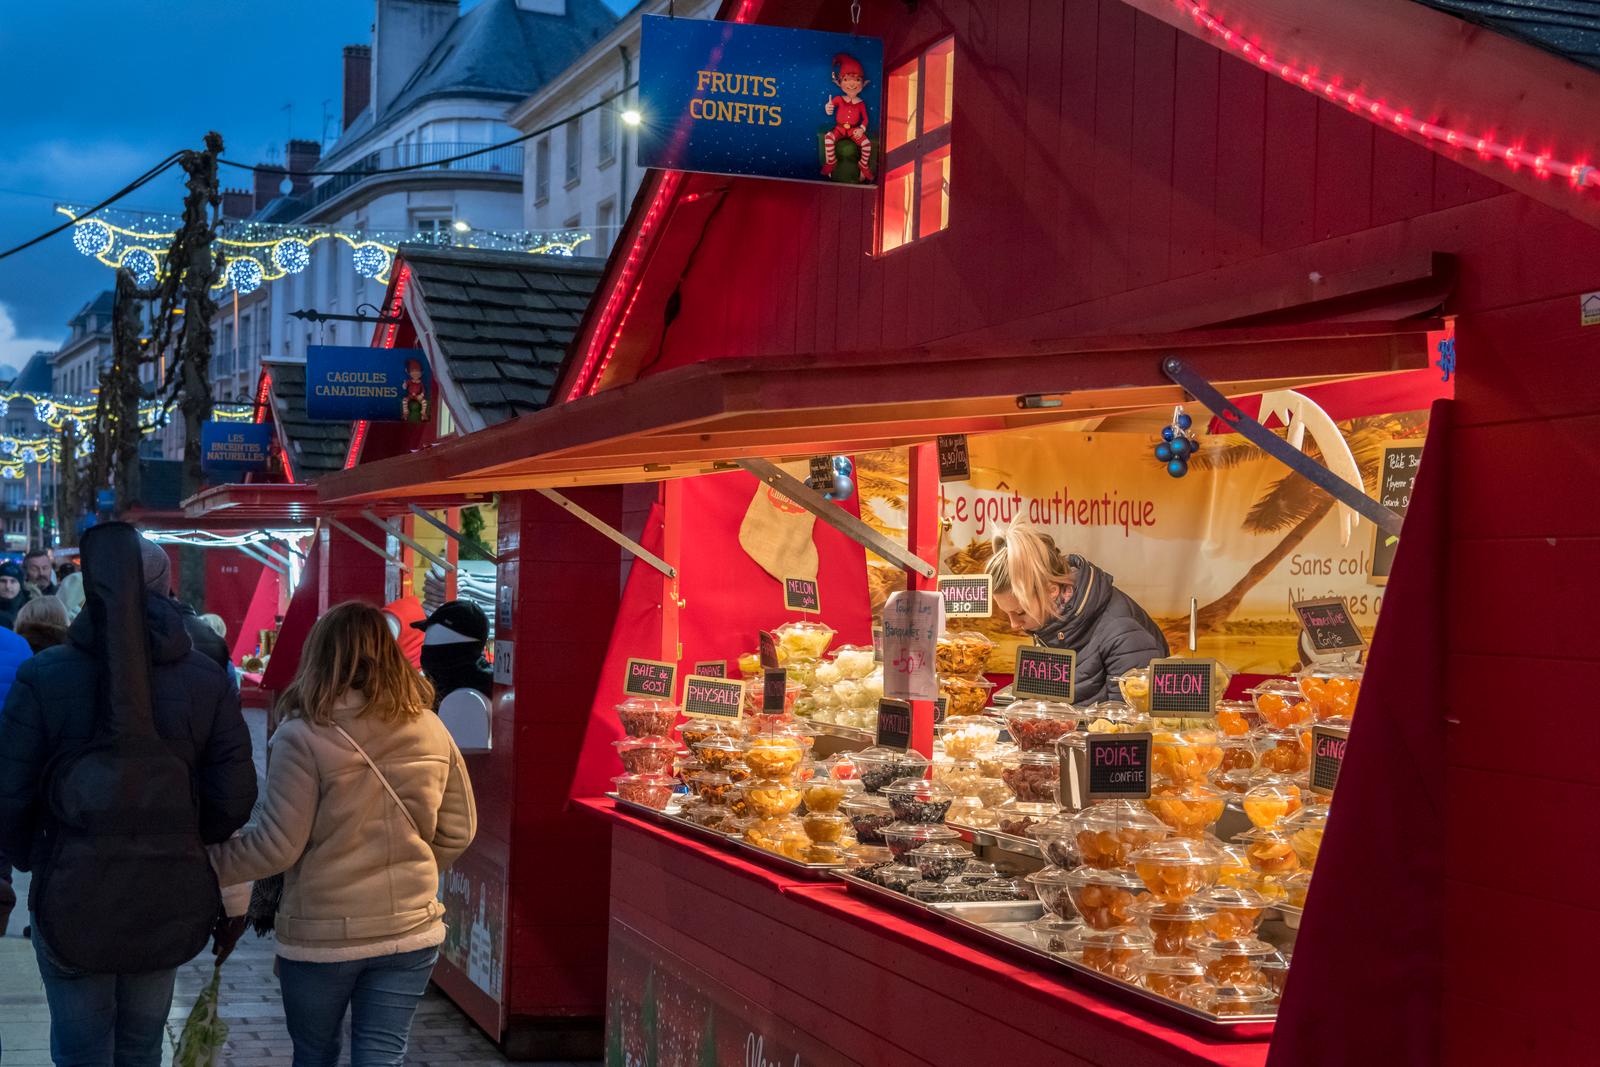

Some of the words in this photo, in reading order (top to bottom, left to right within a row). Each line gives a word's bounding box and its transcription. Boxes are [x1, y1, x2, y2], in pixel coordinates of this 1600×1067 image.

[696, 70, 778, 98] FRUITS
[689, 98, 783, 127] CONFITS
[326, 371, 388, 384] CAGOULES
[315, 385, 399, 398] CANADIENNES
[227, 433, 246, 443] LES
[207, 452, 265, 462] NATURELLES
[941, 484, 969, 524] Le
[974, 481, 1022, 536] goût
[1029, 486, 1156, 538] authentique
[1290, 553, 1333, 577] Sans
[788, 579, 815, 596] MELON
[941, 586, 988, 602] MANGUE
[1021, 657, 1071, 683] FRAISE
[1154, 673, 1203, 696] MELON
[687, 685, 741, 706] PHYSALIS
[1095, 745, 1141, 767] POIRE
[1109, 769, 1145, 784] CONFITE
